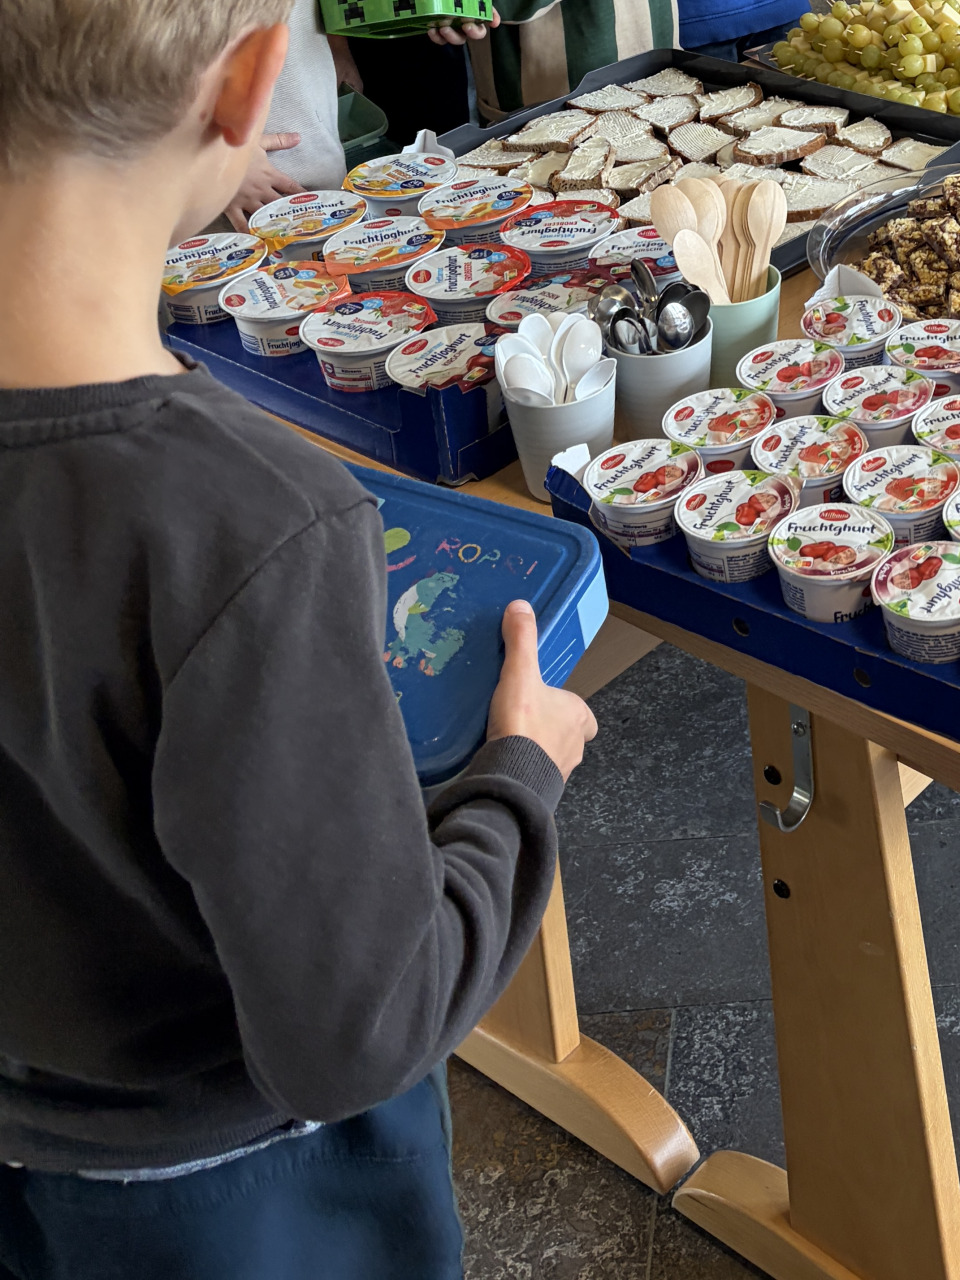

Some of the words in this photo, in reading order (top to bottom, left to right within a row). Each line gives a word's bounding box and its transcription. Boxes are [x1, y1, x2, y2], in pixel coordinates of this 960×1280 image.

[269, 200, 346, 219] Fruchtjoghurt
[435, 183, 508, 205] Fruchtjoghurt
[343, 226, 421, 246] Fruchtjoghurt
[368, 238, 402, 249] APRIKOSE
[520, 226, 597, 237] Fruchtjoghurt
[166, 242, 240, 265] ruchtjoghurt
[444, 255, 462, 293] Fruchtjoghurt
[252, 277, 281, 311] Fruchtjoghurt
[323, 318, 388, 340] Fruchtjoghurt
[857, 299, 879, 336] Fruchtghurt
[408, 332, 472, 375] Fruchtjoghurt
[747, 343, 806, 382] Fruchtghurt
[832, 371, 899, 408] Fruchtghurt
[678, 394, 726, 439] Fruchtghurt
[770, 423, 812, 469] Fruchtghurt
[593, 444, 663, 492] Fruchtghurt
[854, 452, 923, 494] Fruchtghurt
[694, 479, 738, 531] Fruchtghurt
[819, 510, 851, 520] Milbona
[787, 521, 877, 537] Fruchtghurt
